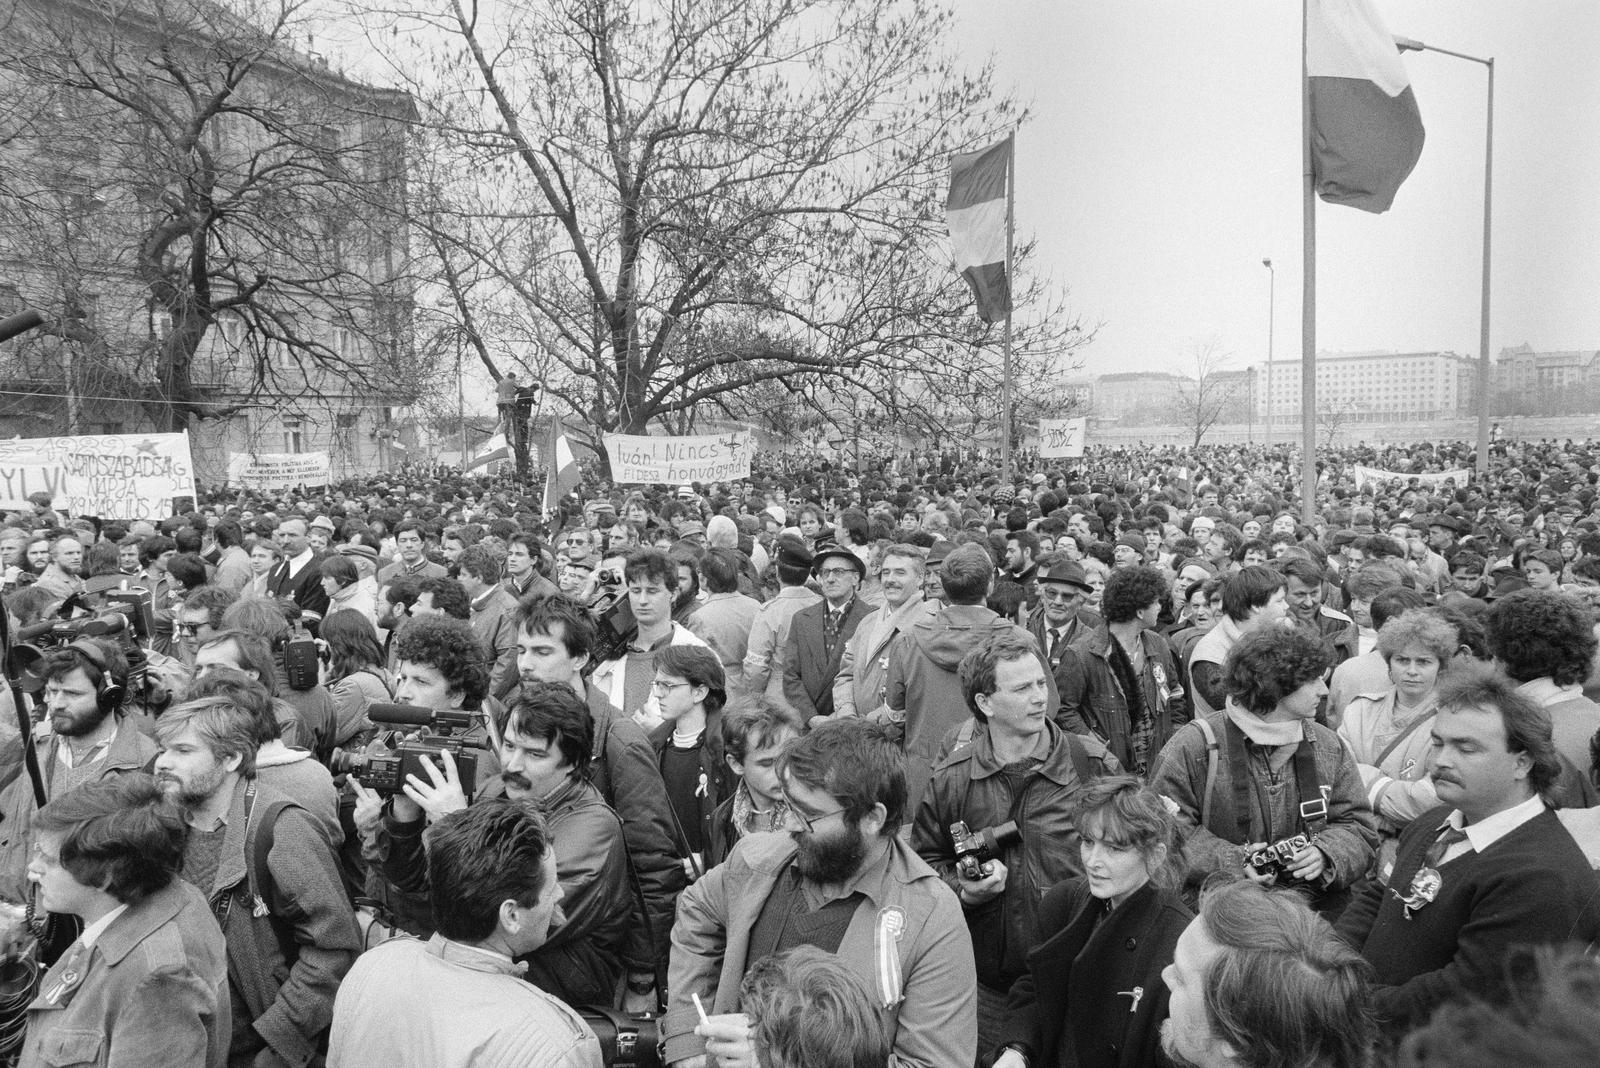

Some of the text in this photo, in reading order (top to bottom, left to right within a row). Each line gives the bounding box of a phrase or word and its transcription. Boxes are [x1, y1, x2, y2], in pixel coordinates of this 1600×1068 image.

[617, 443, 719, 465] Iván! Nincs
[87, 477, 138, 499] NAPJA
